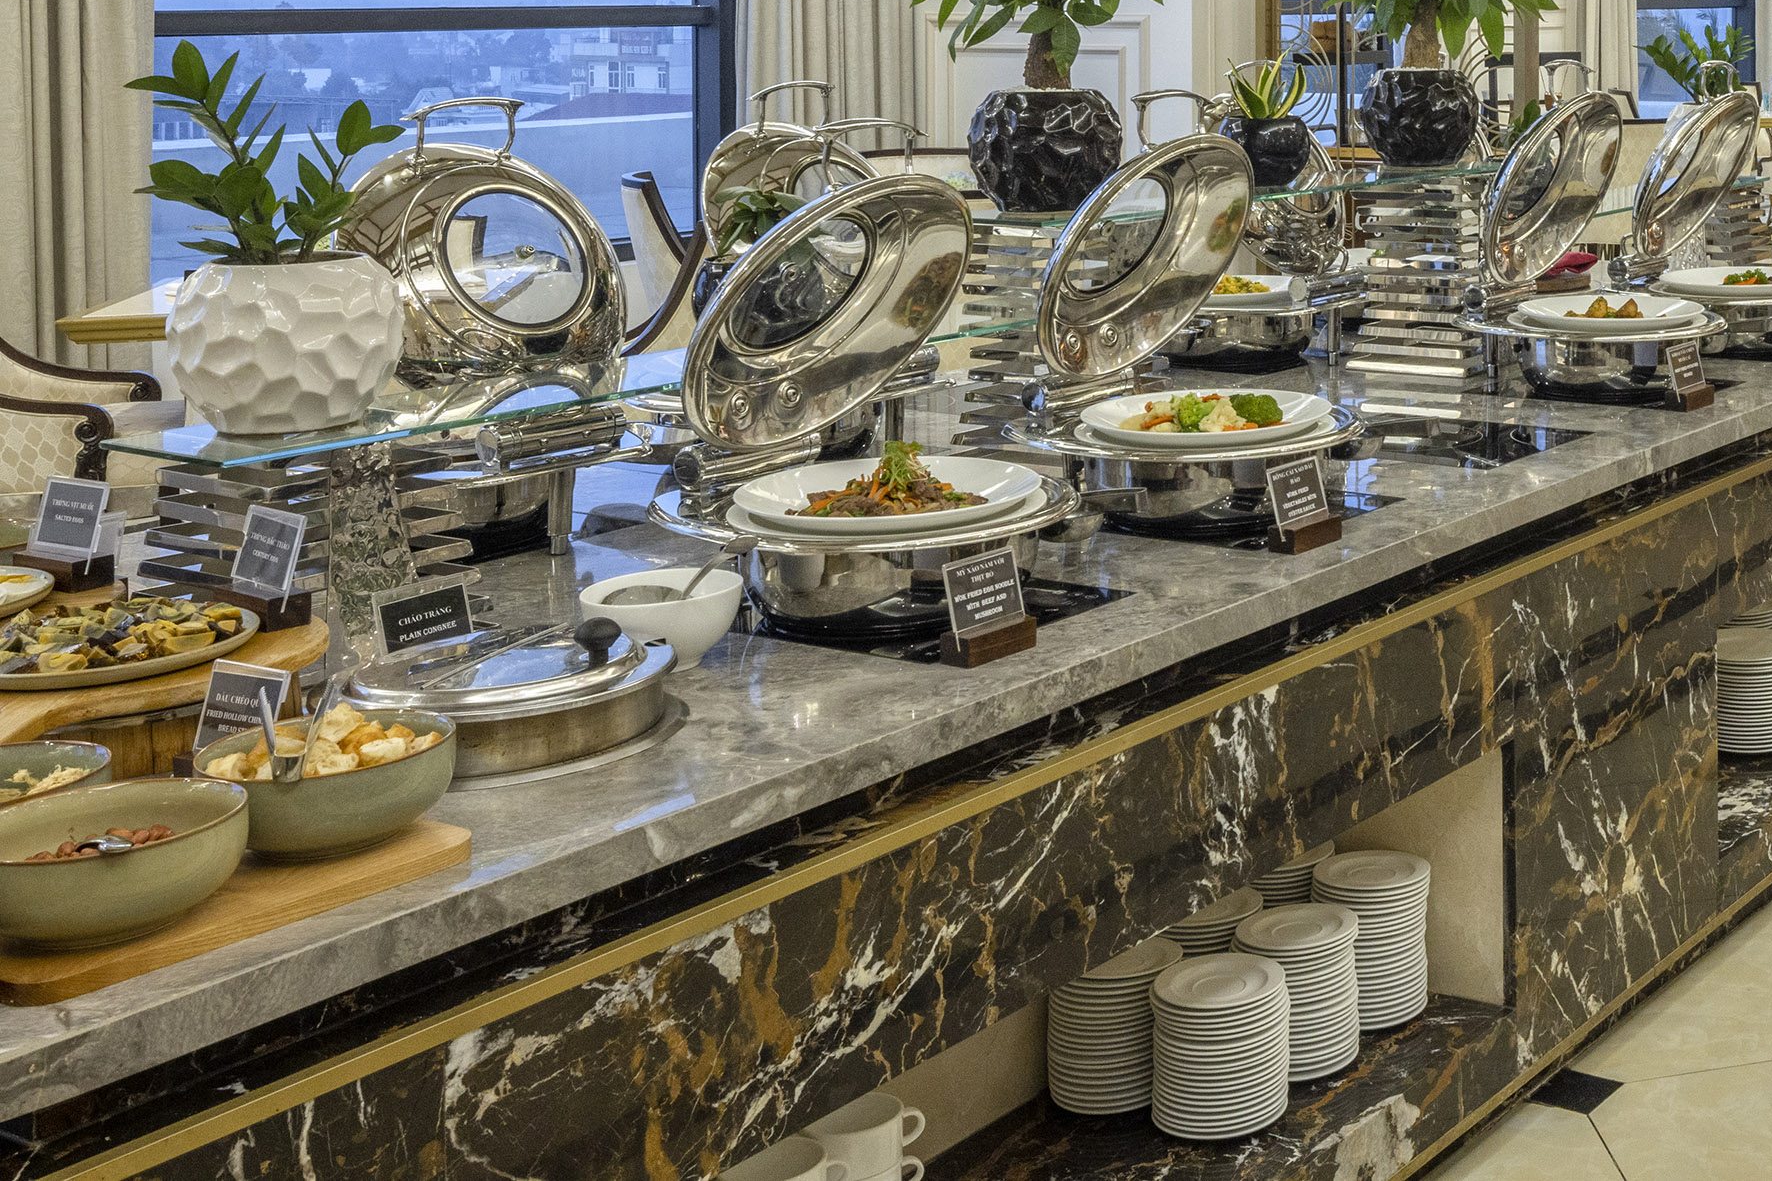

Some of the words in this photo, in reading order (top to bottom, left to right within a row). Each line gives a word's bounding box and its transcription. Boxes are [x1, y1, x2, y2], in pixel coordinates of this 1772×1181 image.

[399, 629, 422, 642] PLAIN
[206, 709, 223, 718] FRIED
[223, 712, 248, 723] HOLLOW
[218, 724, 237, 733] BREAD
